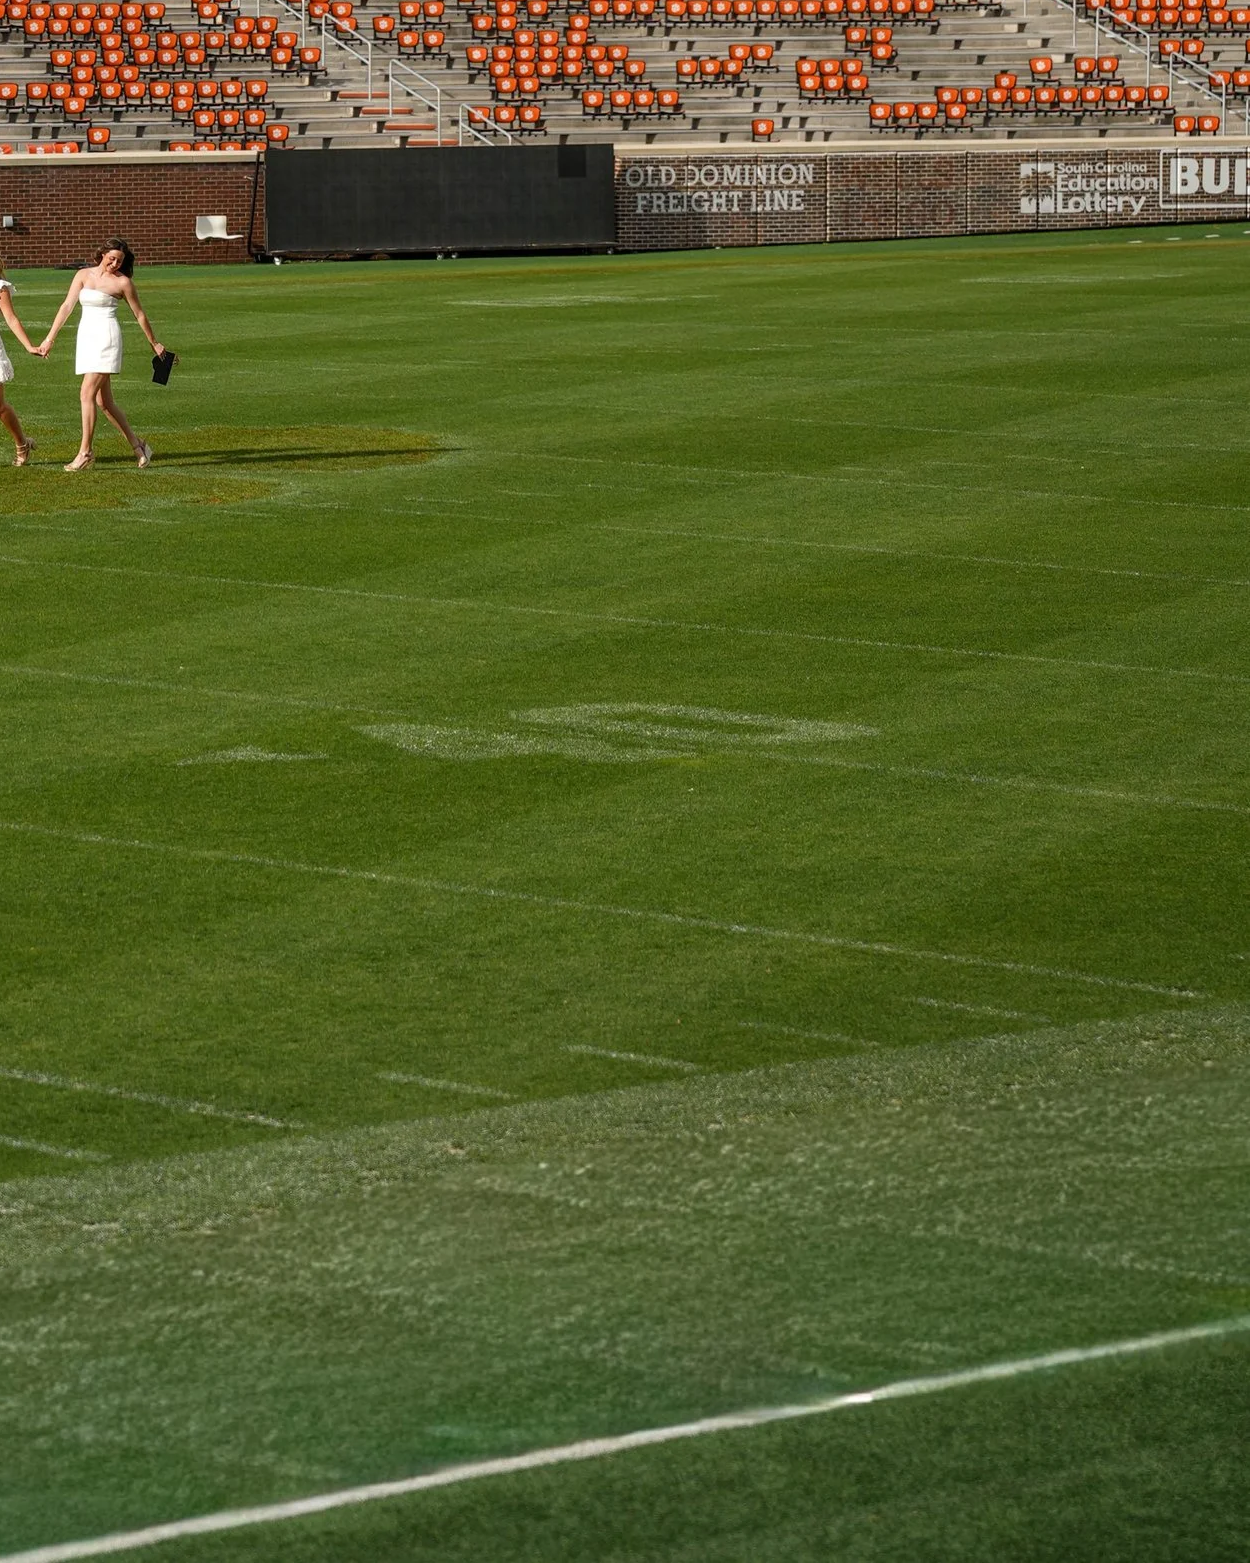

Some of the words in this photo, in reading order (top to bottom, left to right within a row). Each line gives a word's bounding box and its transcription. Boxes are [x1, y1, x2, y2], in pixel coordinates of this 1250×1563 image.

[625, 165, 676, 187] OLD
[683, 163, 814, 186] DOMINION
[1057, 162, 1093, 174] South
[1097, 161, 1147, 173] Carolina
[1056, 175, 1158, 192] Education
[635, 191, 743, 214] FREIGHT
[750, 190, 804, 212] LINE
[1057, 193, 1147, 216] Lottery
